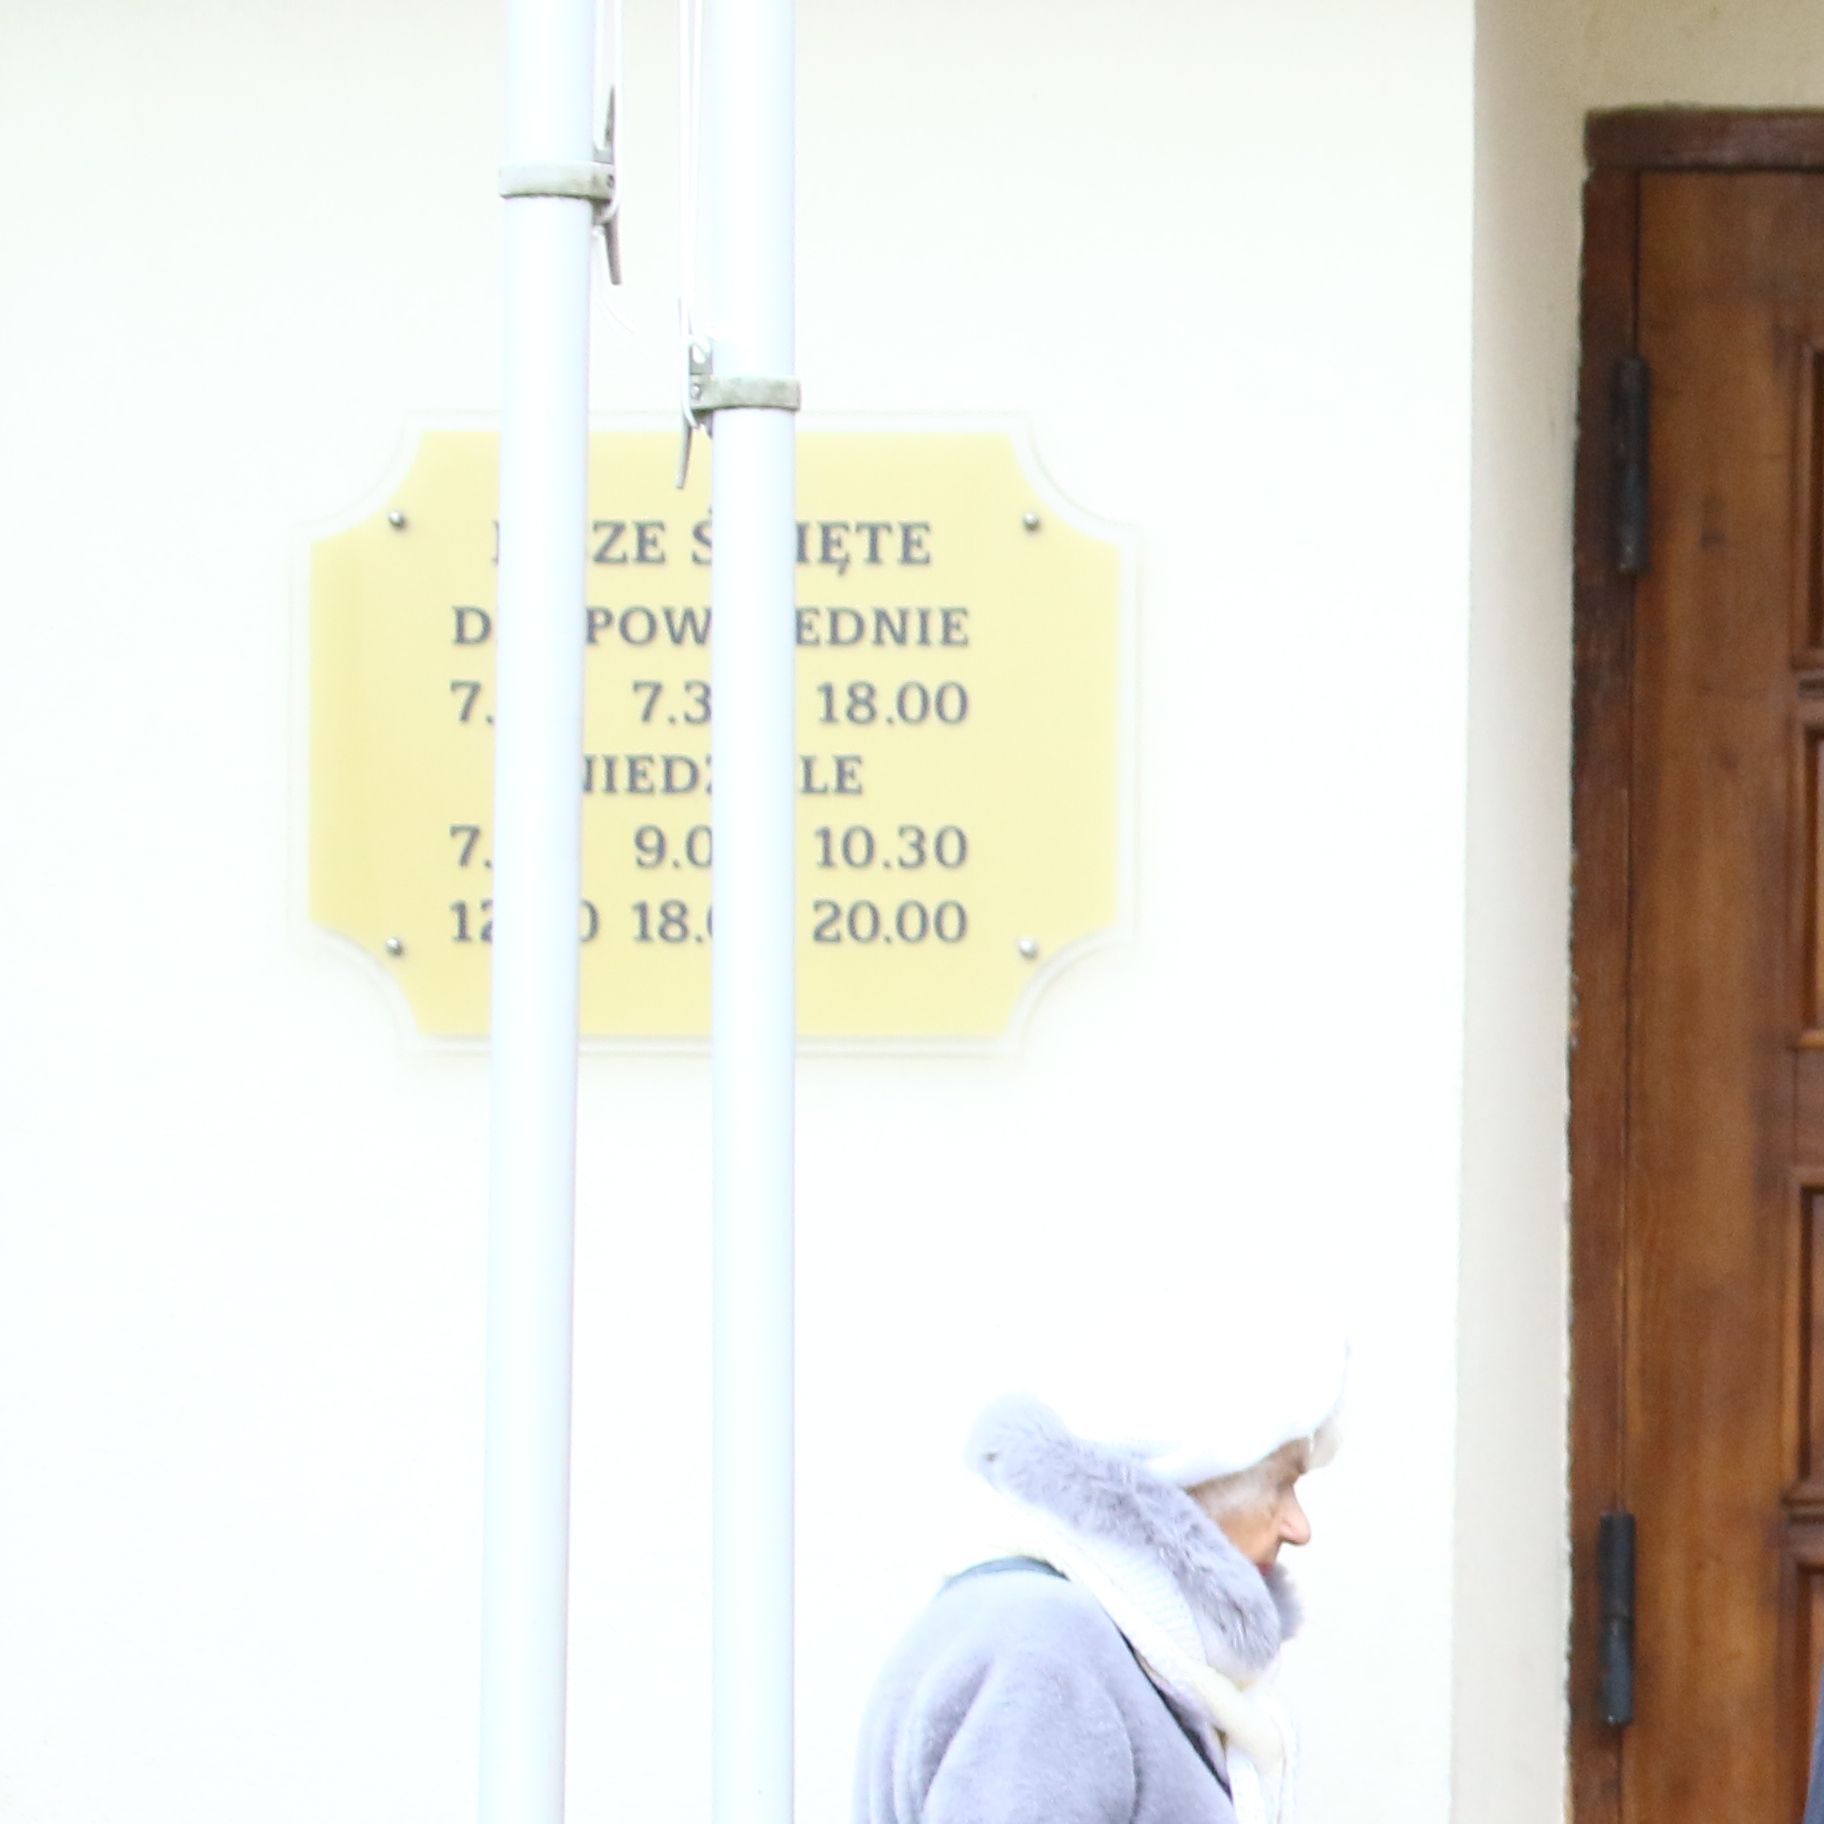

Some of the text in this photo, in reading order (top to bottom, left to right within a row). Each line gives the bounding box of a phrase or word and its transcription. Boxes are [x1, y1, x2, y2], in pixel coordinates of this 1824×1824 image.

[492, 508, 931, 577] ZE ŚIĘTE
[585, 606, 969, 647] POWEDNIE
[633, 680, 711, 725] 7.3
[818, 681, 969, 725] 18.00
[634, 824, 711, 869] 9.0
[815, 825, 968, 869] 10.30
[632, 899, 711, 944] 18.
[812, 899, 968, 944] 20.00
